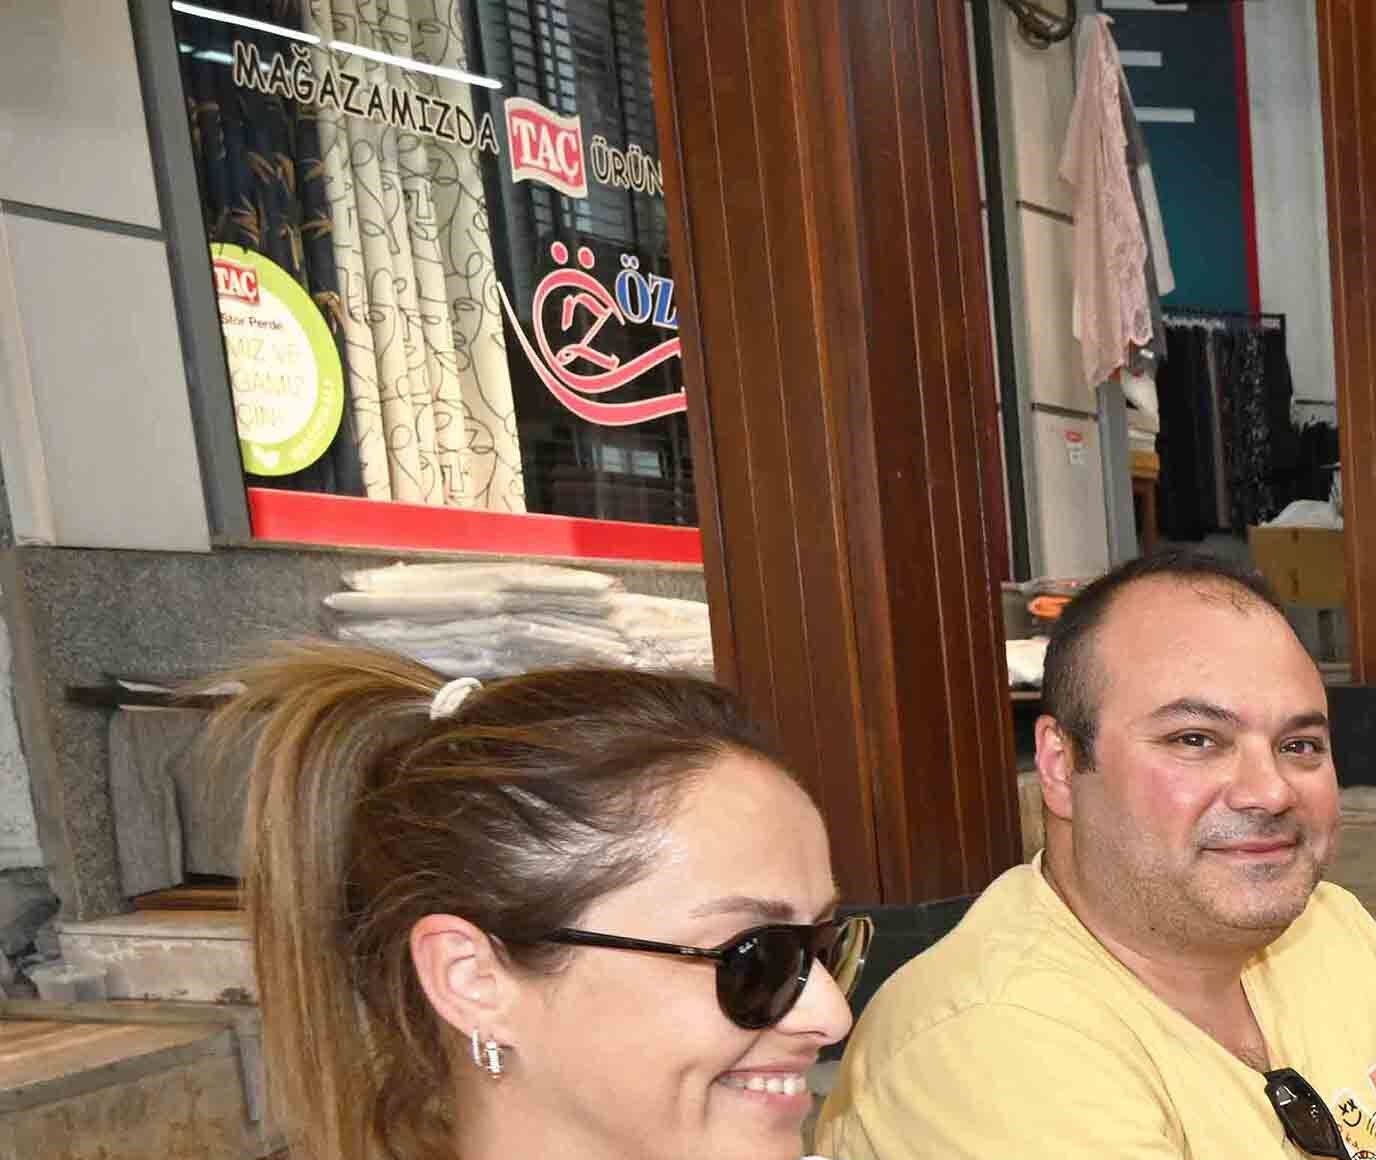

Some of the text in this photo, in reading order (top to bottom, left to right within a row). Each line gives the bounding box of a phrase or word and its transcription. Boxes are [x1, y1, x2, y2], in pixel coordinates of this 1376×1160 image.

[233, 40, 499, 155] MAĞAZAMIZDA
[510, 117, 581, 189] TAÇ
[214, 266, 257, 299] TAÇ
